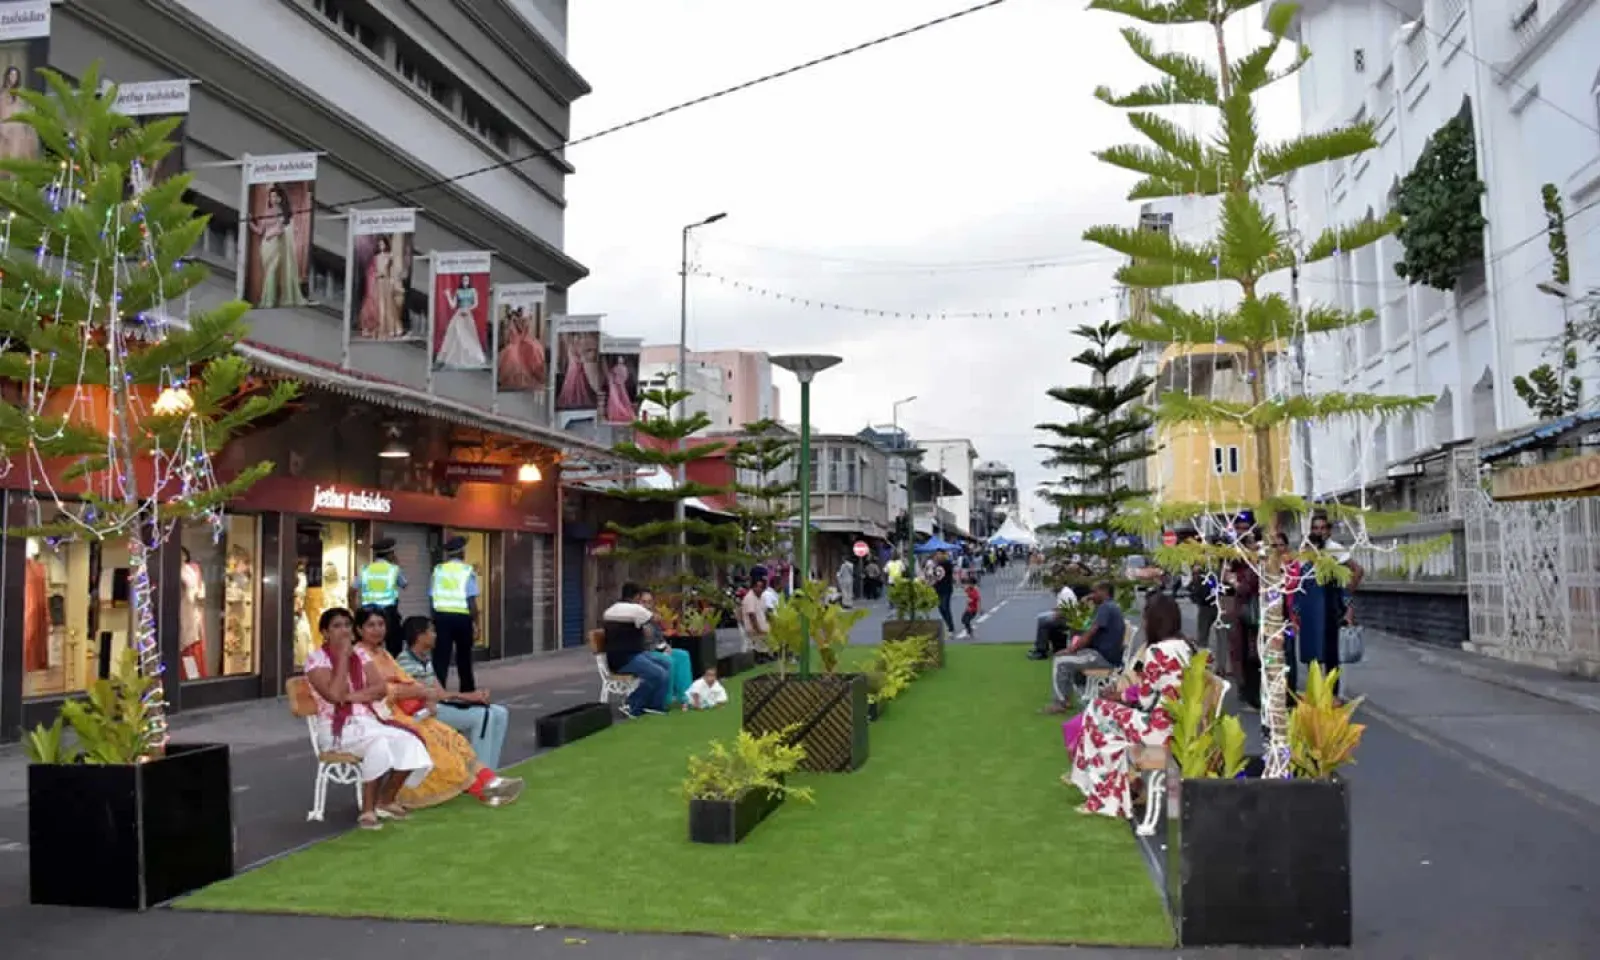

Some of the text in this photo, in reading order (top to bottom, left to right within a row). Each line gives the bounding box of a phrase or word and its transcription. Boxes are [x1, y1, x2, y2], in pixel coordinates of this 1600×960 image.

[1509, 457, 1600, 491] MANJOO
[310, 484, 391, 513] jetha tulsidas
